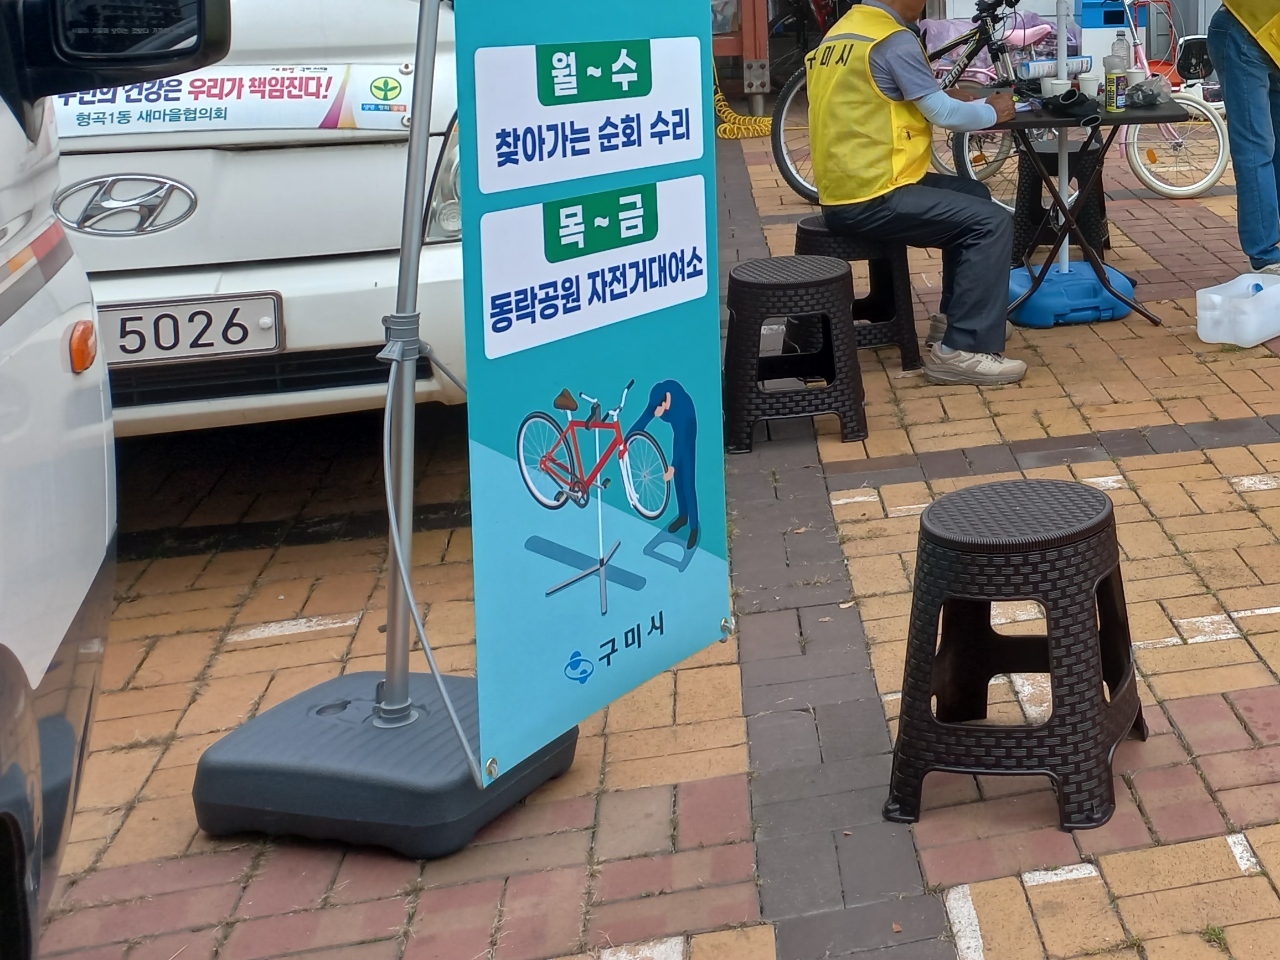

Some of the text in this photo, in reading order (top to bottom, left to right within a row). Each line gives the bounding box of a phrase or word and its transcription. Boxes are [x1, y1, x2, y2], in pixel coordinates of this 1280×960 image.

[188, 77, 244, 100] 우리가
[248, 76, 333, 100] 책임진다!
[76, 106, 228, 127] 형곡1동 새마을협의회
[494, 107, 691, 168] 찾아가는 순회 수리
[490, 246, 704, 333] 동락공원 자전거대여소
[118, 307, 249, 354] 5026
